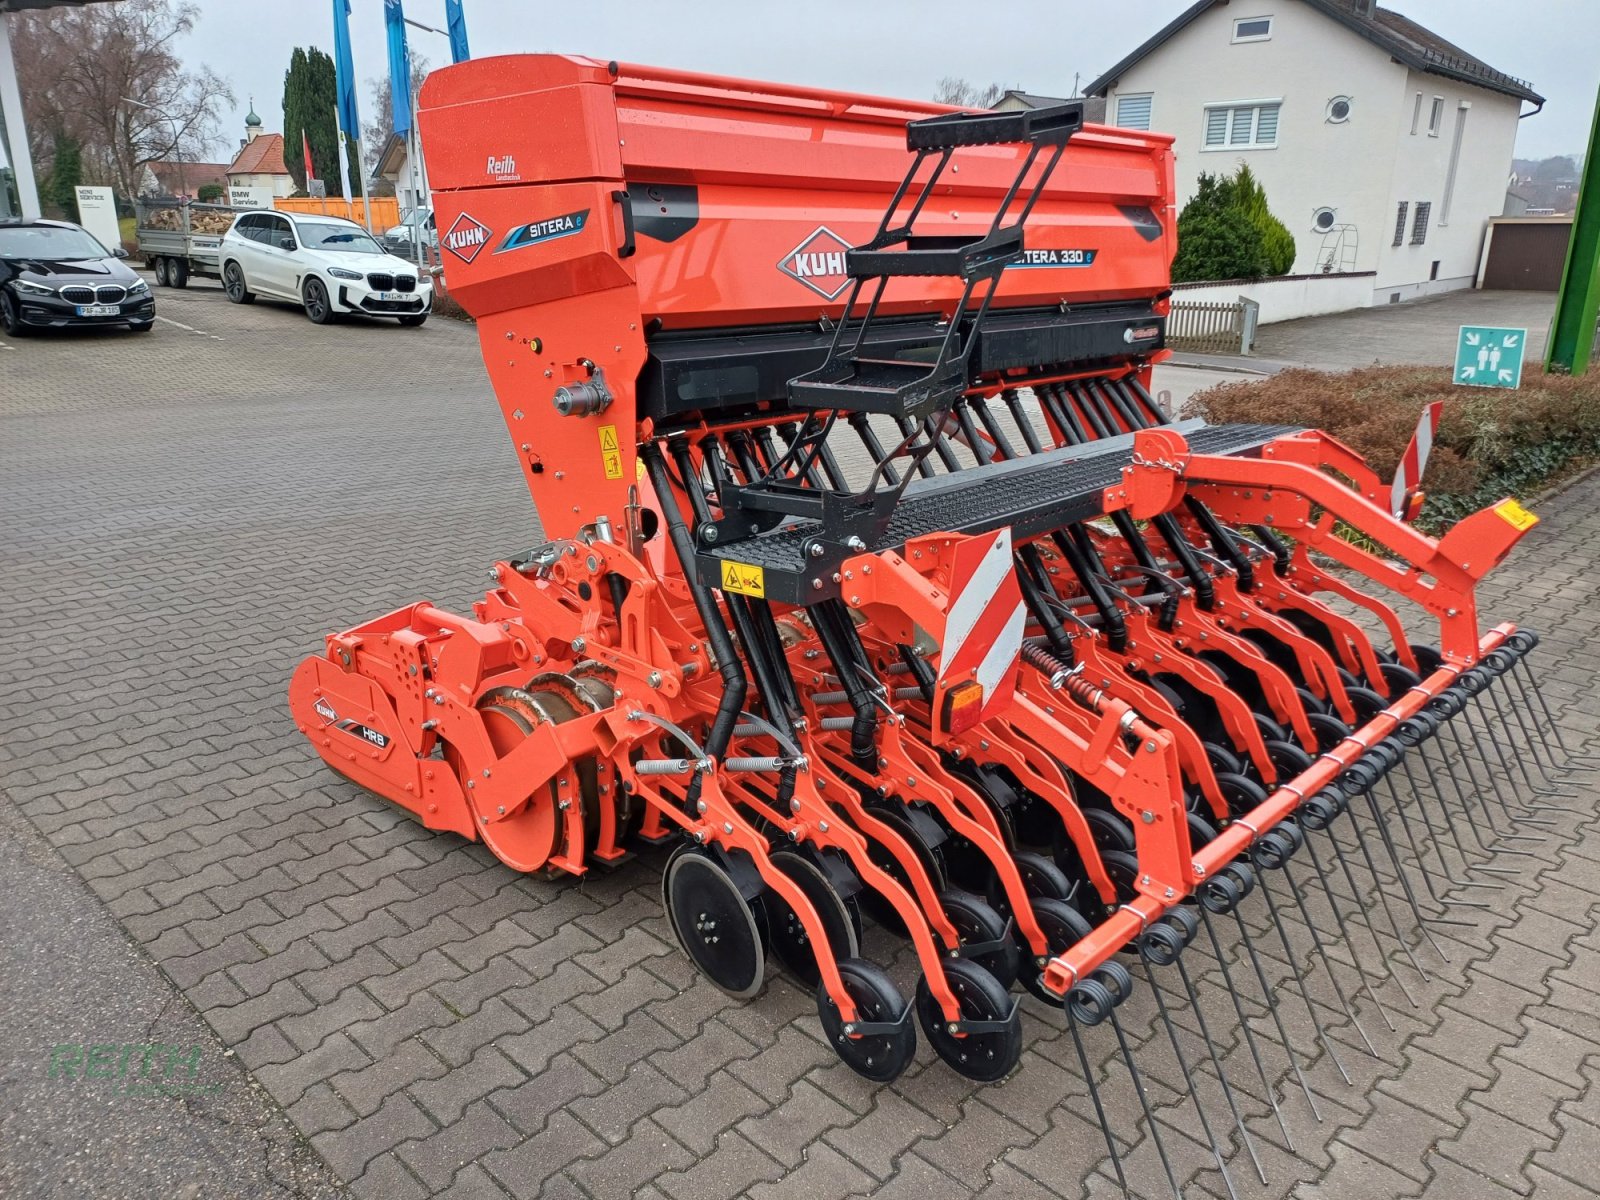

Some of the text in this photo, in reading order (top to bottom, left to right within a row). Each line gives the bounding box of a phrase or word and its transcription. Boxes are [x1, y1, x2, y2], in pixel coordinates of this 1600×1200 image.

[487, 155, 516, 175] Reith
[232, 198, 258, 206] Service
[529, 216, 574, 238] SITERA
[449, 227, 484, 250] KUHN
[1014, 250, 1058, 264] TERA
[1060, 250, 1083, 264] 330
[316, 703, 336, 721] KUHN
[362, 726, 385, 747] HRB
